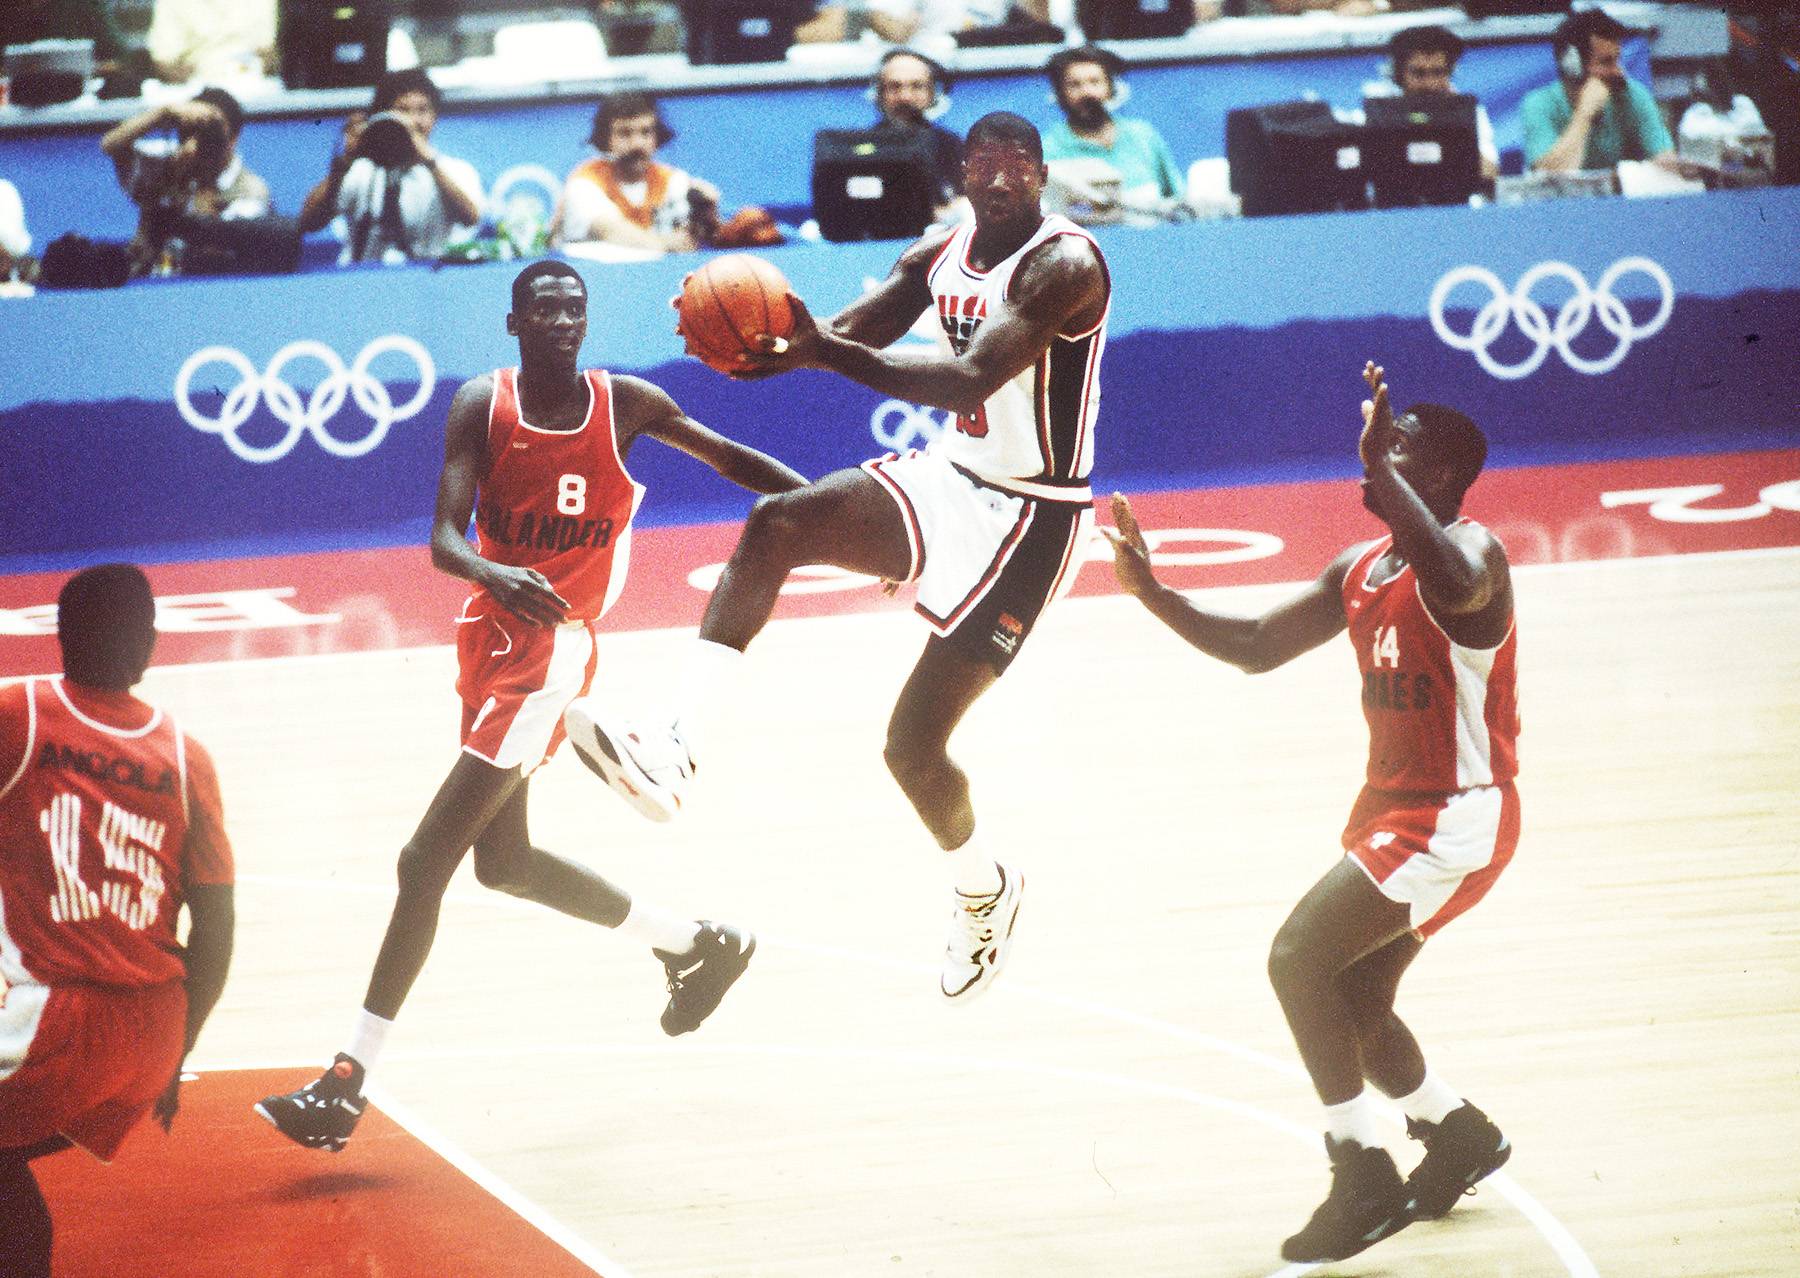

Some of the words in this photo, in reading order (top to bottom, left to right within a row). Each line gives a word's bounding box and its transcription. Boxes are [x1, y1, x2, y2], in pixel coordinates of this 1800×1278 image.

[557, 473, 587, 516] 8
[1372, 625, 1400, 669] 14
[38, 740, 176, 796] ANGOLA
[39, 792, 166, 931] 15
